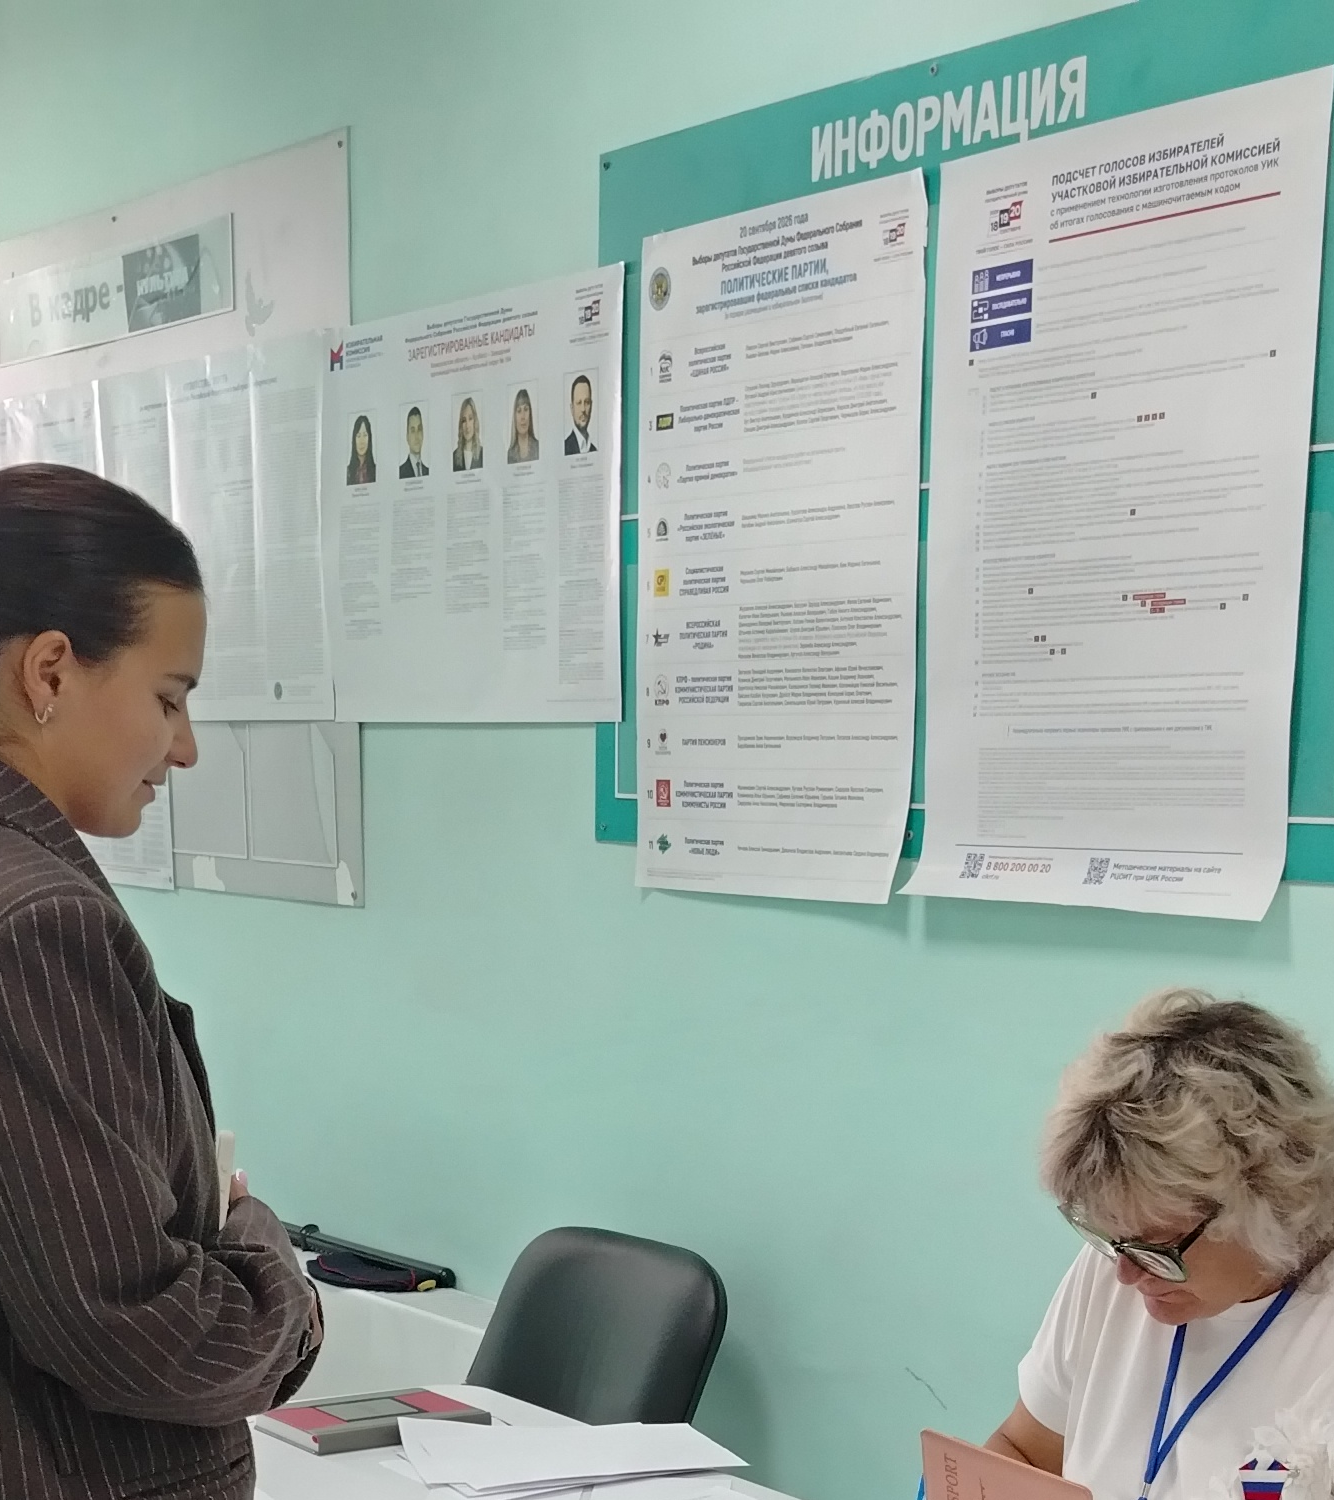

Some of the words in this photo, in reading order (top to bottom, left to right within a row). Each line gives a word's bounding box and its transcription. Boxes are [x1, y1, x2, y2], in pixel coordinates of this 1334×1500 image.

[810, 55, 1087, 183] ИНФОРМАЦИЯ
[1051, 175, 1116, 203] УЧАСТКОВОЙ
[1118, 155, 1208, 187] ИЗБИРАТЕЛЬНОЙ
[1211, 138, 1281, 166] КОМИССИЕЙ
[1052, 166, 1097, 186] ПОДСЧЕТ
[1099, 154, 1146, 175] ГОЛОСОВ
[1148, 133, 1225, 163] ИЗБИРАТЕЛЕЙ
[1049, 219, 1058, 230] об
[1060, 217, 1084, 228] итогах
[1086, 205, 1134, 223] голосования
[1135, 203, 1140, 212] с
[1142, 189, 1213, 210] машиночитаемым
[1214, 182, 1240, 196] кодом
[1050, 209, 1055, 217] с
[1056, 198, 1106, 216] применением
[1107, 188, 1151, 203] технологии
[1153, 174, 1208, 193] изготовления
[1210, 162, 1259, 184] протоколов
[1261, 157, 1279, 171] УИК
[740, 226, 747, 238] 20
[749, 220, 776, 236] сентября
[778, 215, 792, 229] 2026
[794, 213, 808, 226] года
[990, 221, 998, 232] 18
[1000, 213, 1008, 224] 19
[1010, 205, 1020, 216] 20
[721, 267, 789, 295] ПОЛИТИЧЕСКИЕ
[791, 258, 828, 280] ПАРТИИ,
[29, 293, 42, 328] В
[408, 333, 489, 362] ЗАРЕГИСТРИРОВАННЫЕ
[491, 323, 535, 344] КАНДИДАТЫ
[986, 862, 992, 870] 8
[993, 862, 1009, 871] 800
[1010, 863, 1026, 872] 200
[1028, 863, 1039, 873] 00
[1040, 864, 1051, 873] 20
[1113, 863, 1157, 872] Методические
[1158, 865, 1192, 873] материалы
